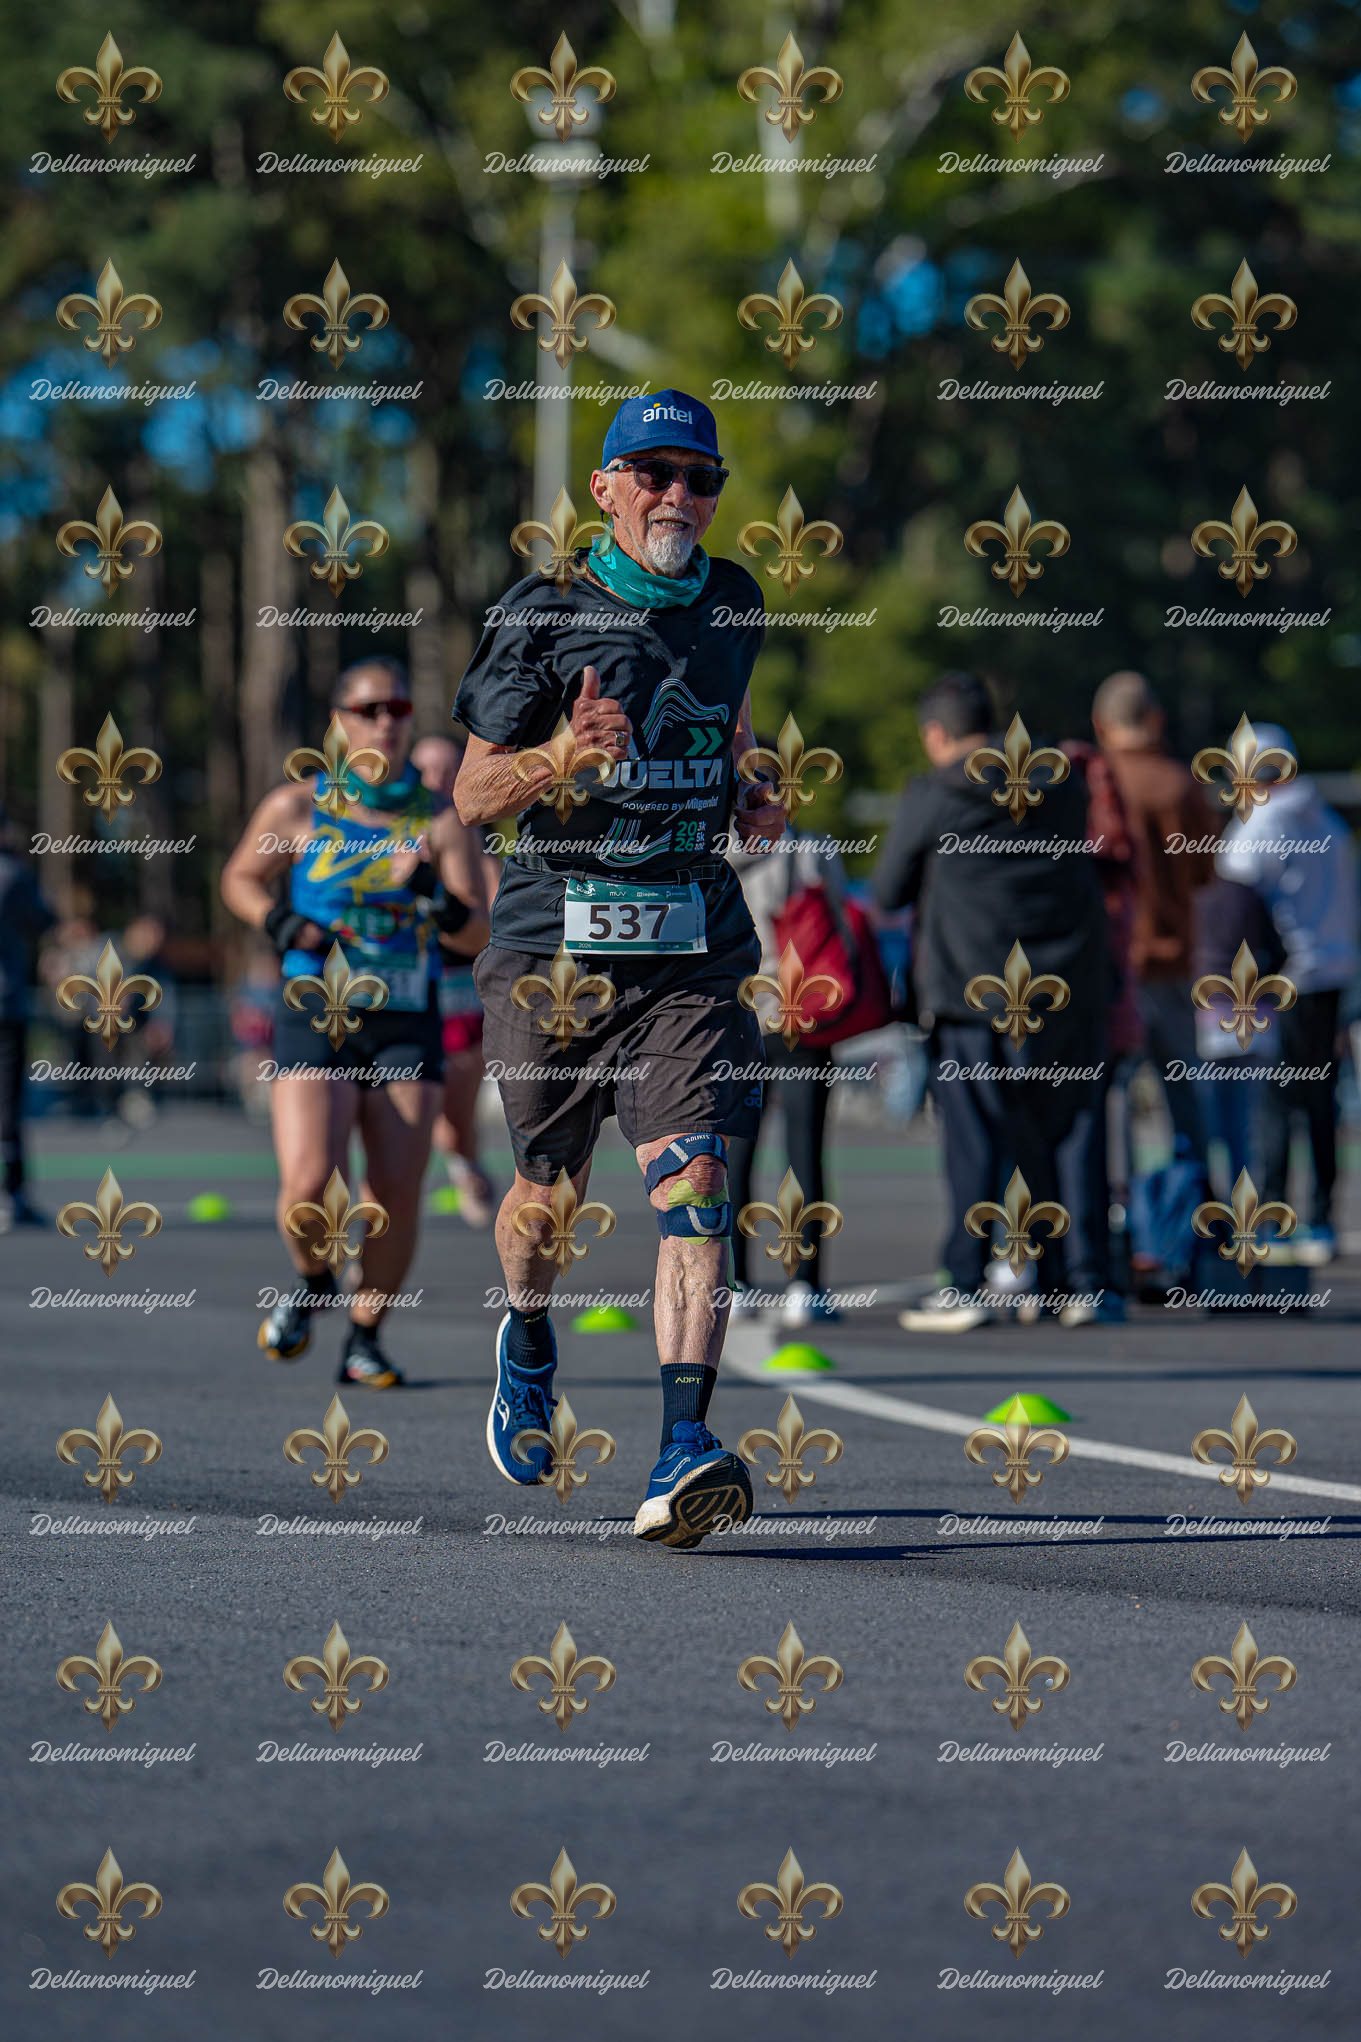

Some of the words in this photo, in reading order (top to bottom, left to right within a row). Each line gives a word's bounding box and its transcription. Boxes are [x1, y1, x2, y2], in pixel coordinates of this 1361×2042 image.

[643, 403, 692, 424] antel
[622, 802, 669, 811] POWERED
[676, 821, 698, 837] 20
[674, 837, 695, 852] 26
[588, 904, 670, 940] 537
